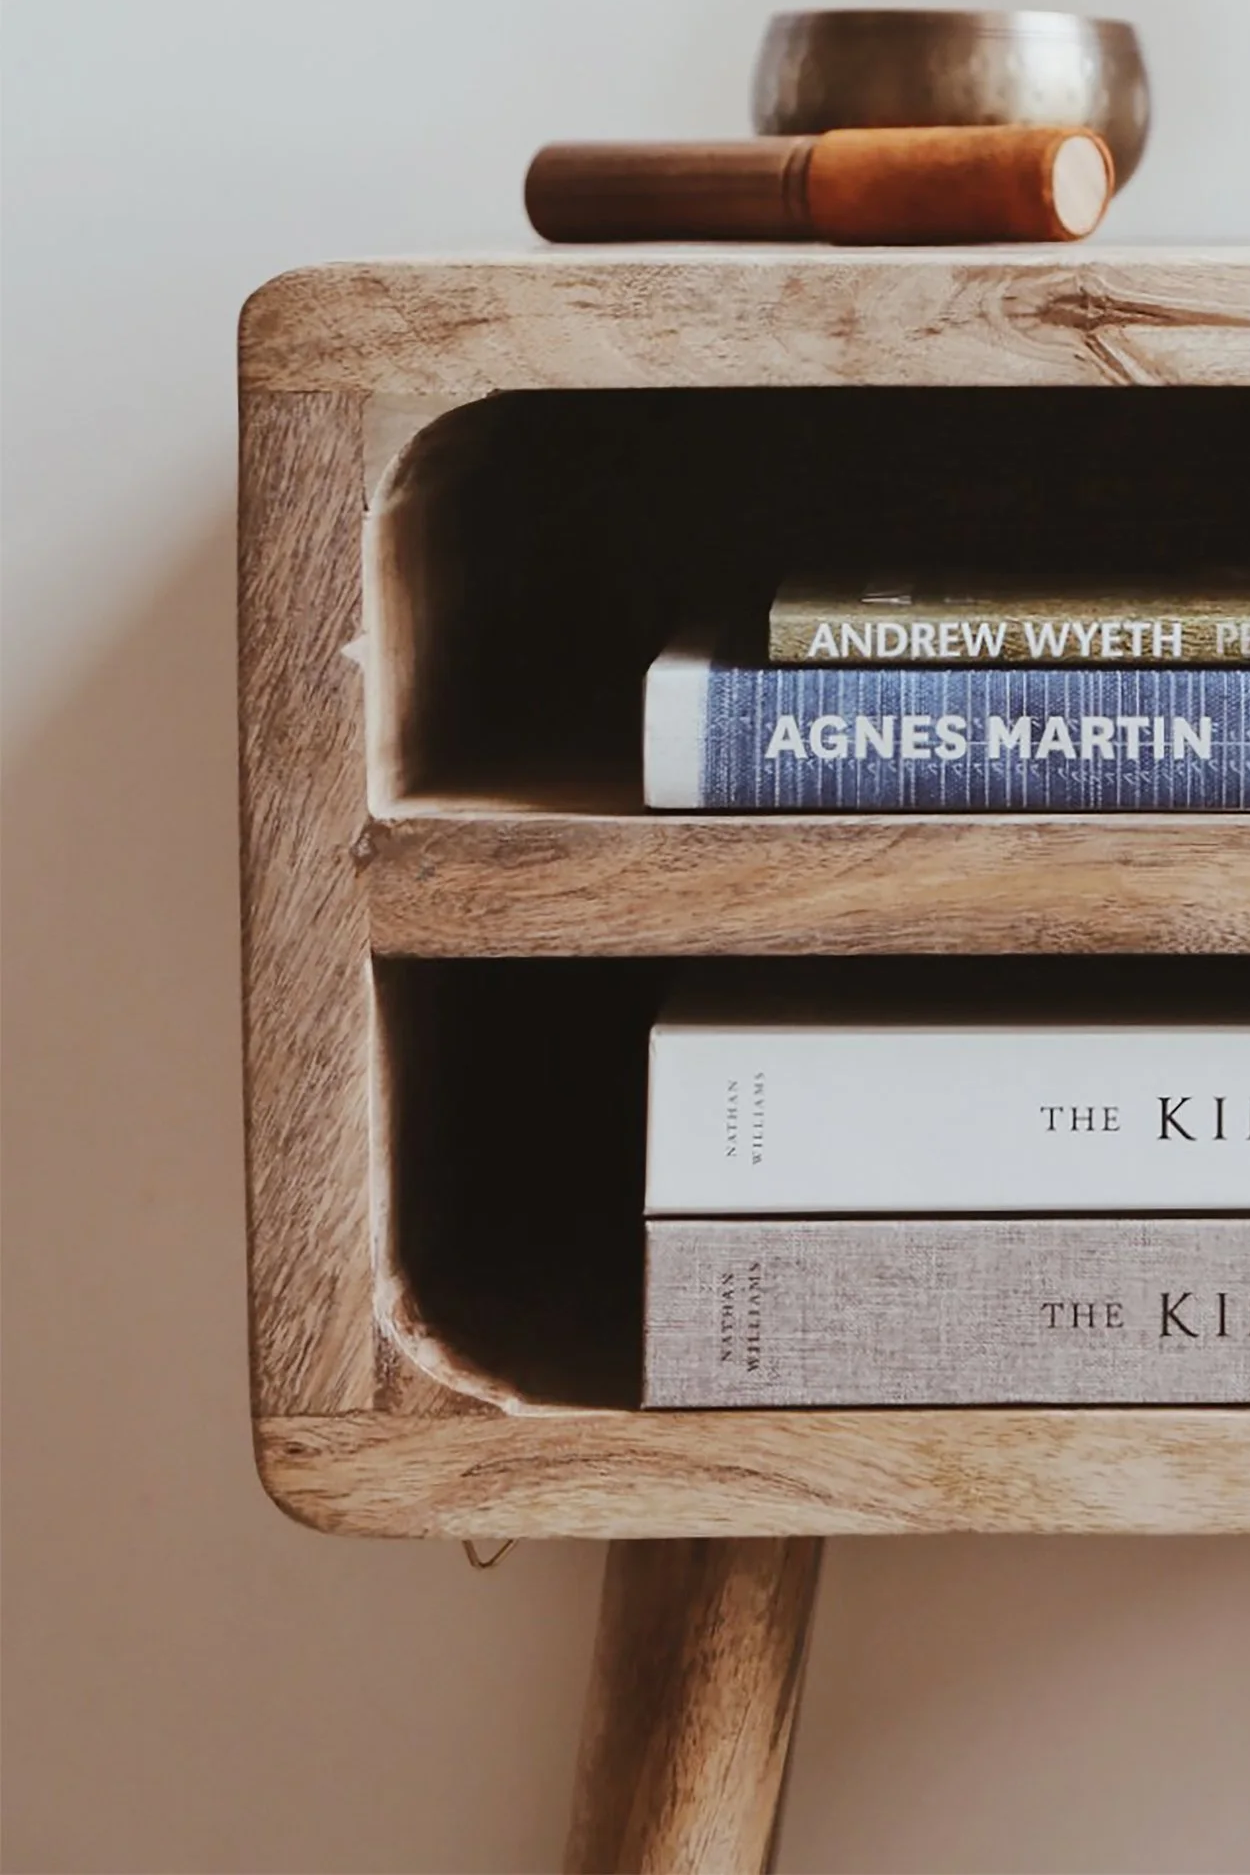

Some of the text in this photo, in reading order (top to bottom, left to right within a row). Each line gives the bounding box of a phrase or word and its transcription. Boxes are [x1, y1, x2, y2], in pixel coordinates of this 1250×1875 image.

[806, 621, 1006, 659] ANDREW
[1024, 622, 1183, 659] WYETH
[764, 714, 1213, 761] AGNES MARTIN
[725, 1080, 738, 1158] NATHAN
[752, 1072, 765, 1165] WILLIAMS
[1041, 1106, 1120, 1131] THE
[720, 1273, 734, 1362] NATHAN
[747, 1261, 761, 1373] WILLIAMS
[1041, 1302, 1124, 1328] THE
